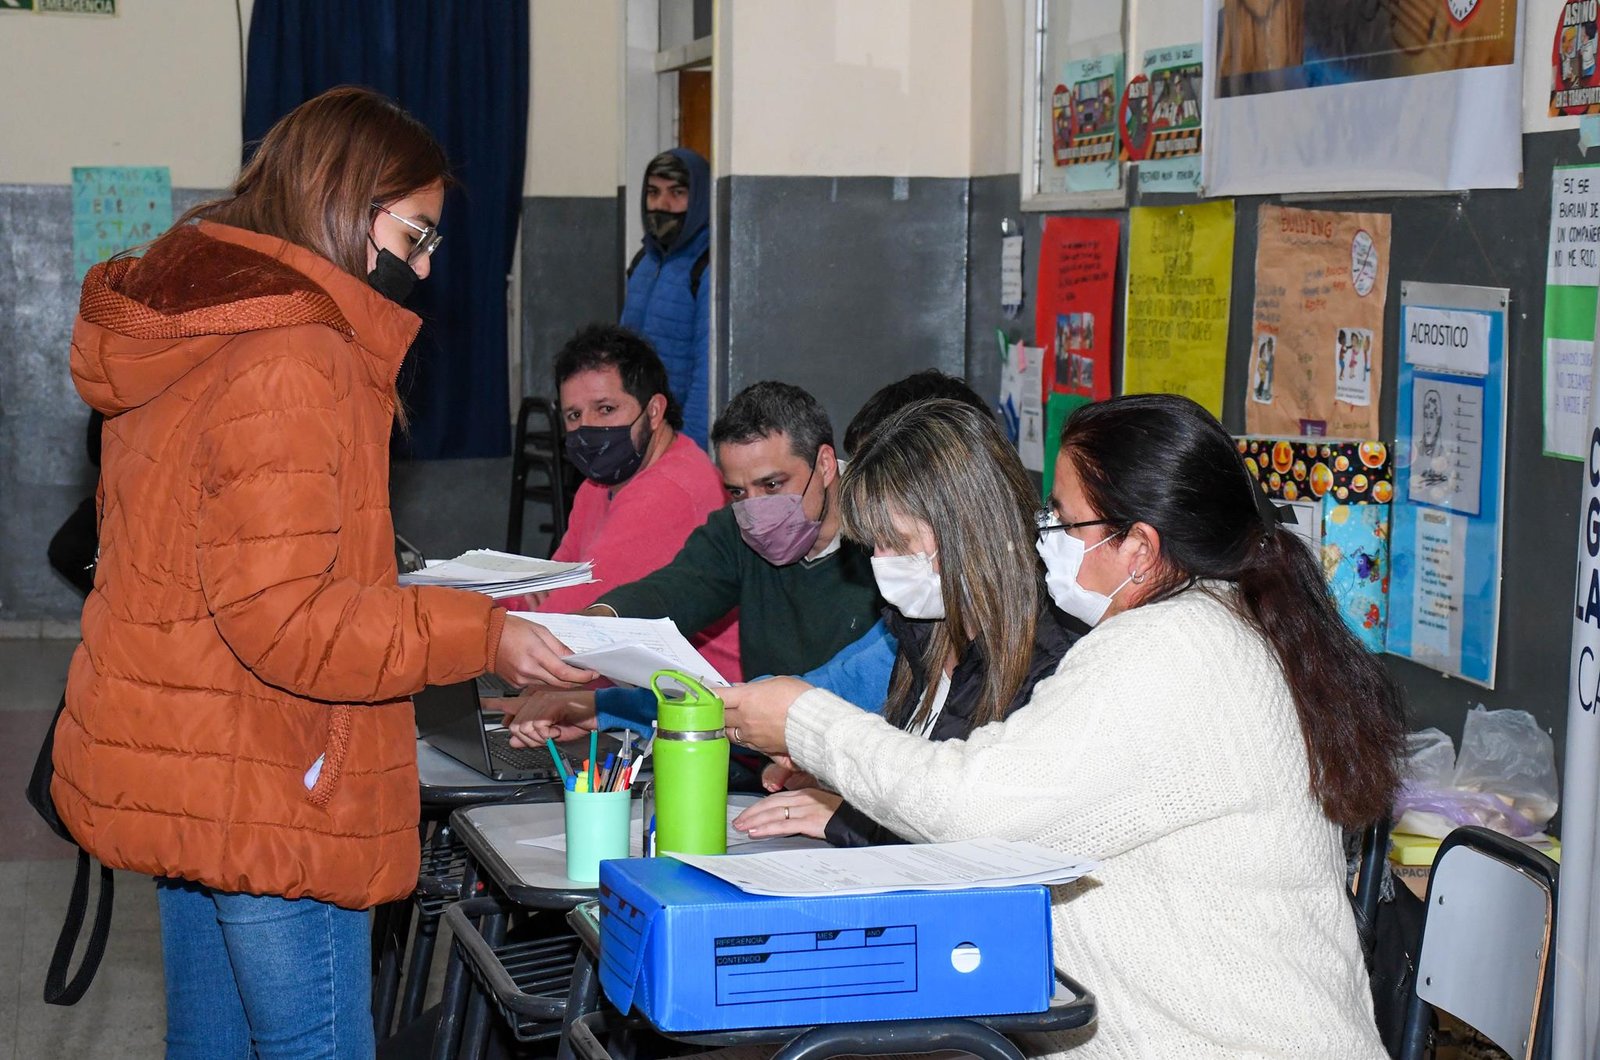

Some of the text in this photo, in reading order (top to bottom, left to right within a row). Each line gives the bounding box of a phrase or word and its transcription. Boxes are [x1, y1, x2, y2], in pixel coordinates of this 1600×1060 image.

[40, 0, 114, 14] EMERGENCIA
[1563, 178, 1590, 194] SI SE
[1559, 202, 1599, 218] BURLAN DE
[1280, 216, 1333, 239] BULLYING
[1557, 226, 1566, 243] UN
[1568, 249, 1577, 267] ME
[1410, 321, 1469, 348] ACROSTICO
[716, 955, 761, 965] CONTENIDO
